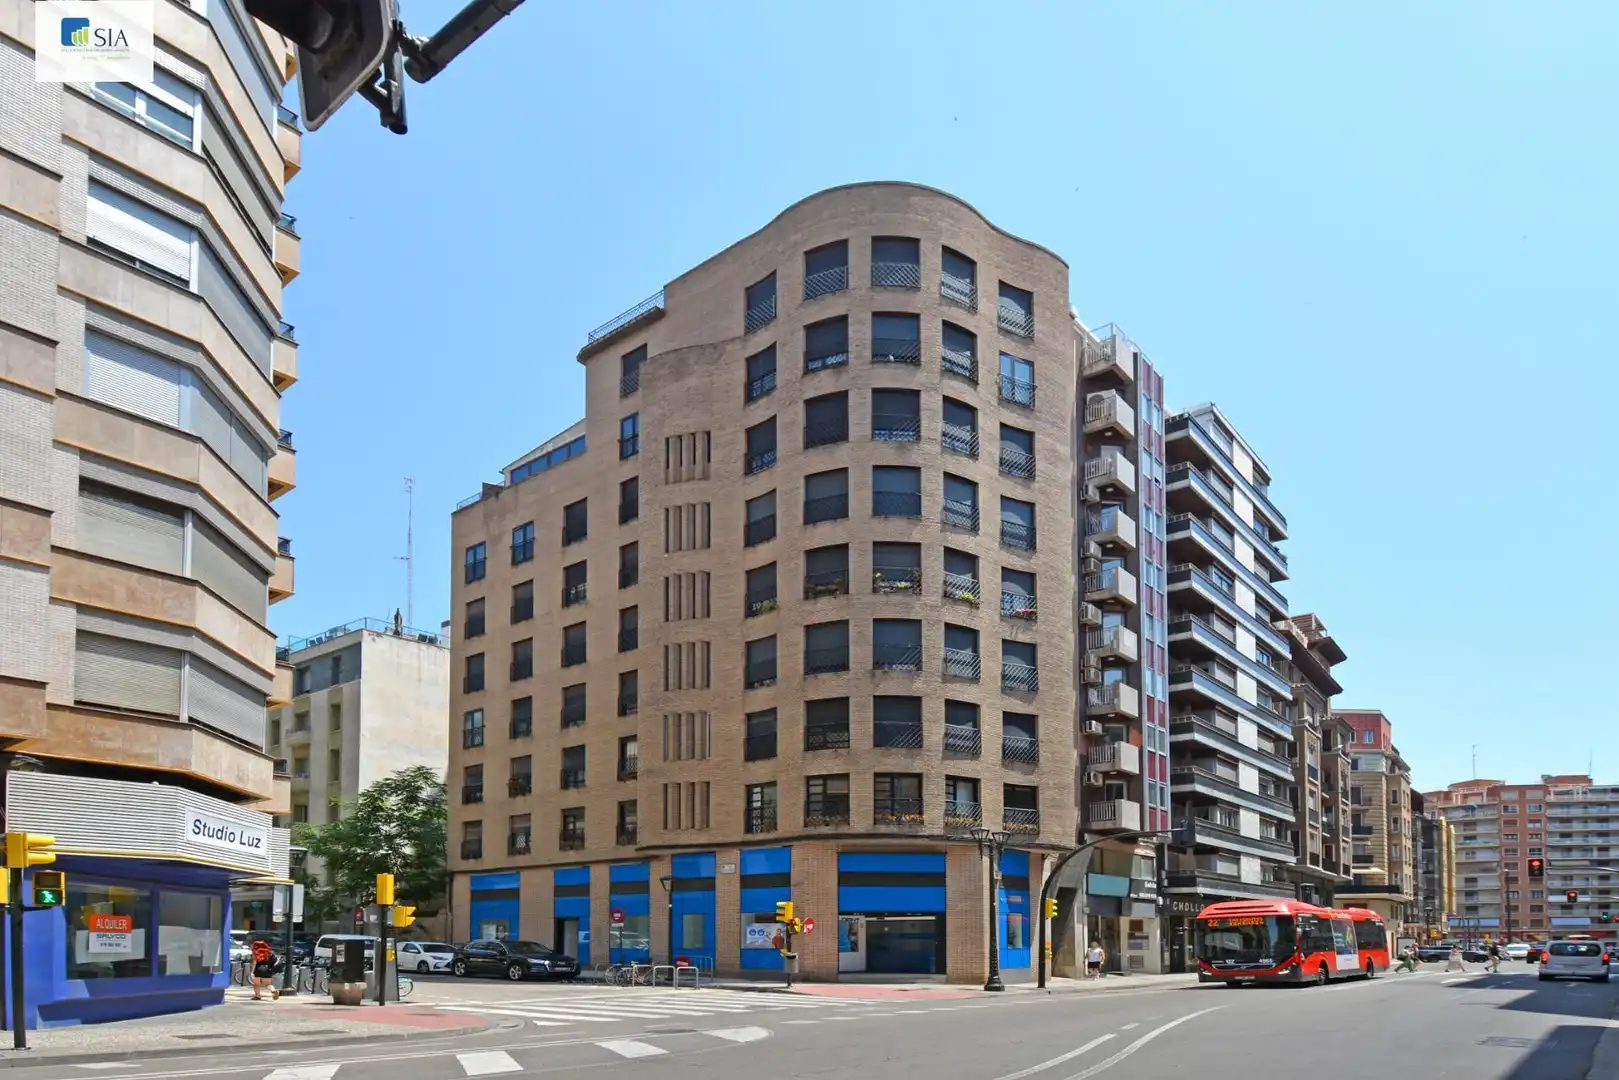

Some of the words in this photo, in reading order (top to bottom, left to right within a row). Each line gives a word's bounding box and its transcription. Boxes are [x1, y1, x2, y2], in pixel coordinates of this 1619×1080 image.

[192, 819, 236, 843] Studio
[239, 830, 261, 848] Luz
[96, 918, 127, 930] ALQUILER
[1208, 919, 1218, 927] 22
